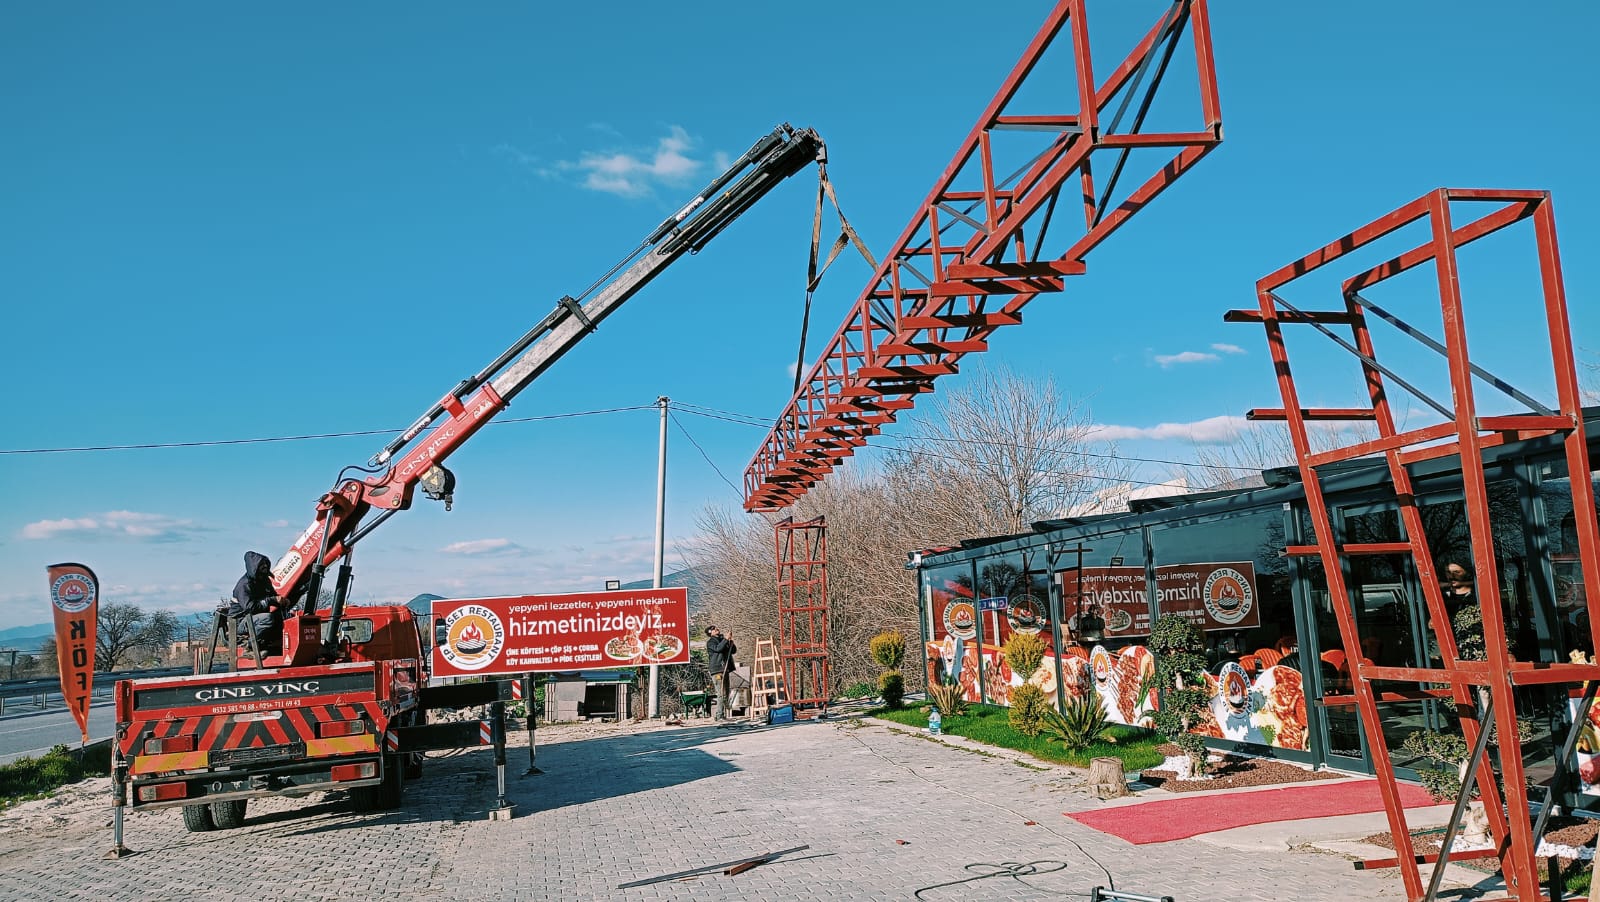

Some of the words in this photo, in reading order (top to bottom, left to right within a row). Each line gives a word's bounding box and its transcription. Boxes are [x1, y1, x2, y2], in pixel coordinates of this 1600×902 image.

[508, 602, 548, 614] yepyeni
[550, 599, 594, 610] lezzetler,
[595, 597, 633, 610] yepyeni
[636, 596, 677, 606] mekan...
[443, 649, 455, 660] EP
[469, 606, 503, 660] RESTAURANT
[509, 609, 677, 636] hizmetinizdeyiz...
[195, 687, 256, 702] ÇİNE
[260, 681, 320, 696] VİNÇ
